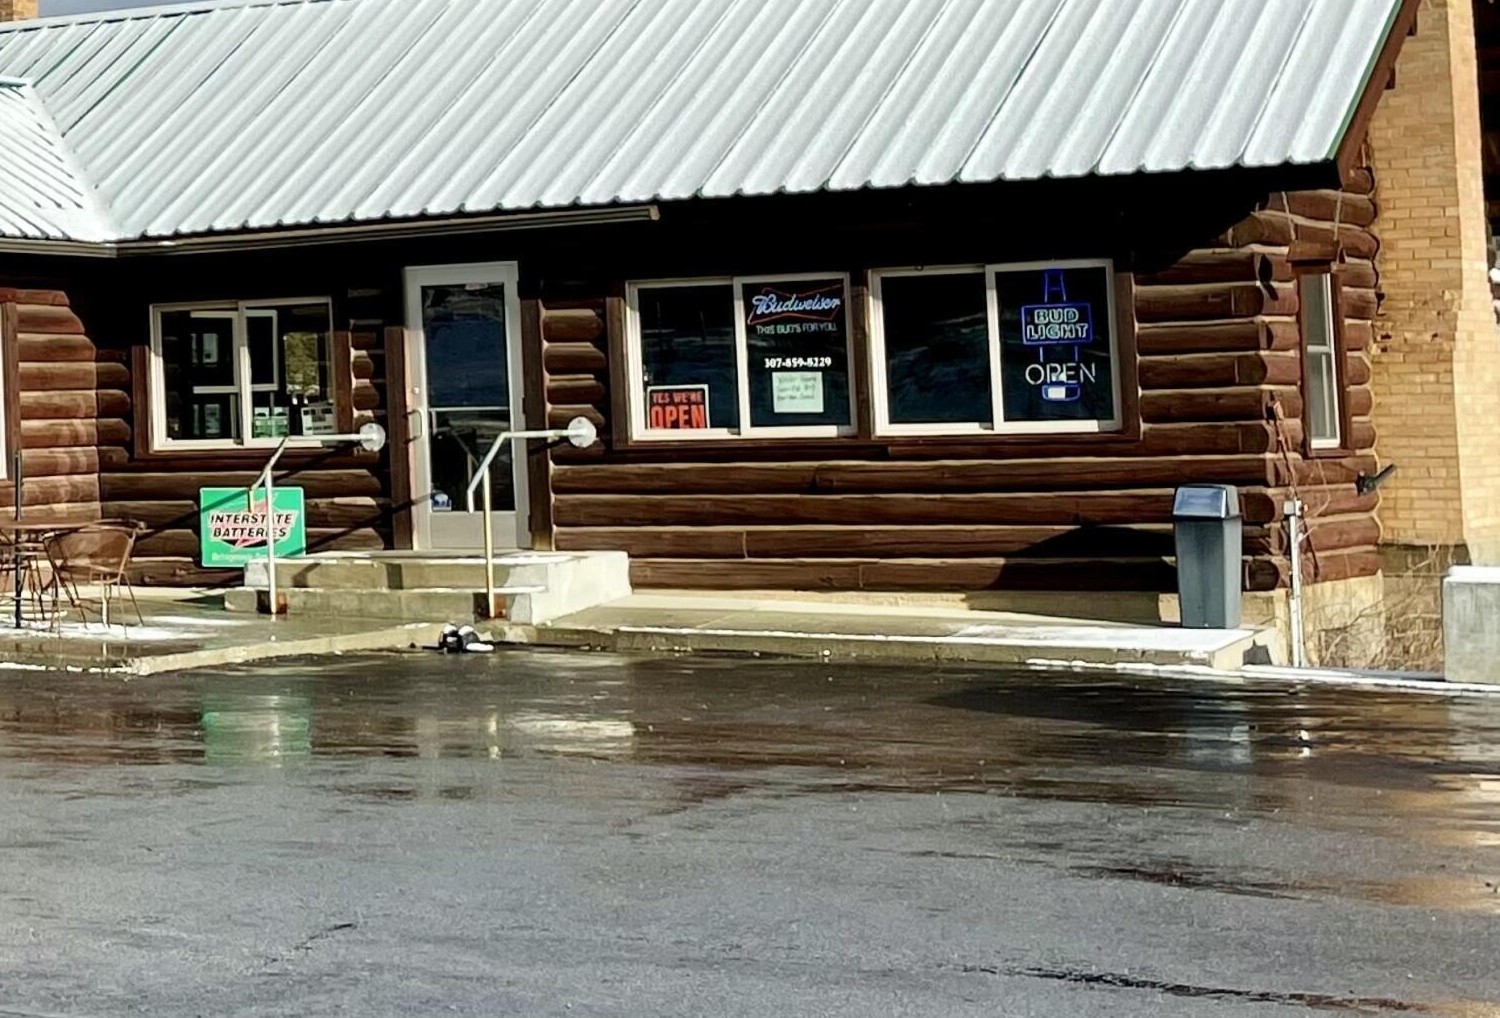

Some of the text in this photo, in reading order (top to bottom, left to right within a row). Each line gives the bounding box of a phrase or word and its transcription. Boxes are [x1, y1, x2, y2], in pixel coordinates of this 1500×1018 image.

[752, 294, 841, 315] Budweiser
[1034, 308, 1079, 324] BUD
[756, 324, 775, 335] THIS
[802, 322, 819, 333] FOR
[1026, 323, 1089, 340] LIGHT
[1025, 362, 1096, 385] OPEN
[652, 392, 669, 404] YES
[650, 405, 705, 429] OPEN
[210, 513, 293, 524] INTERSTTE
